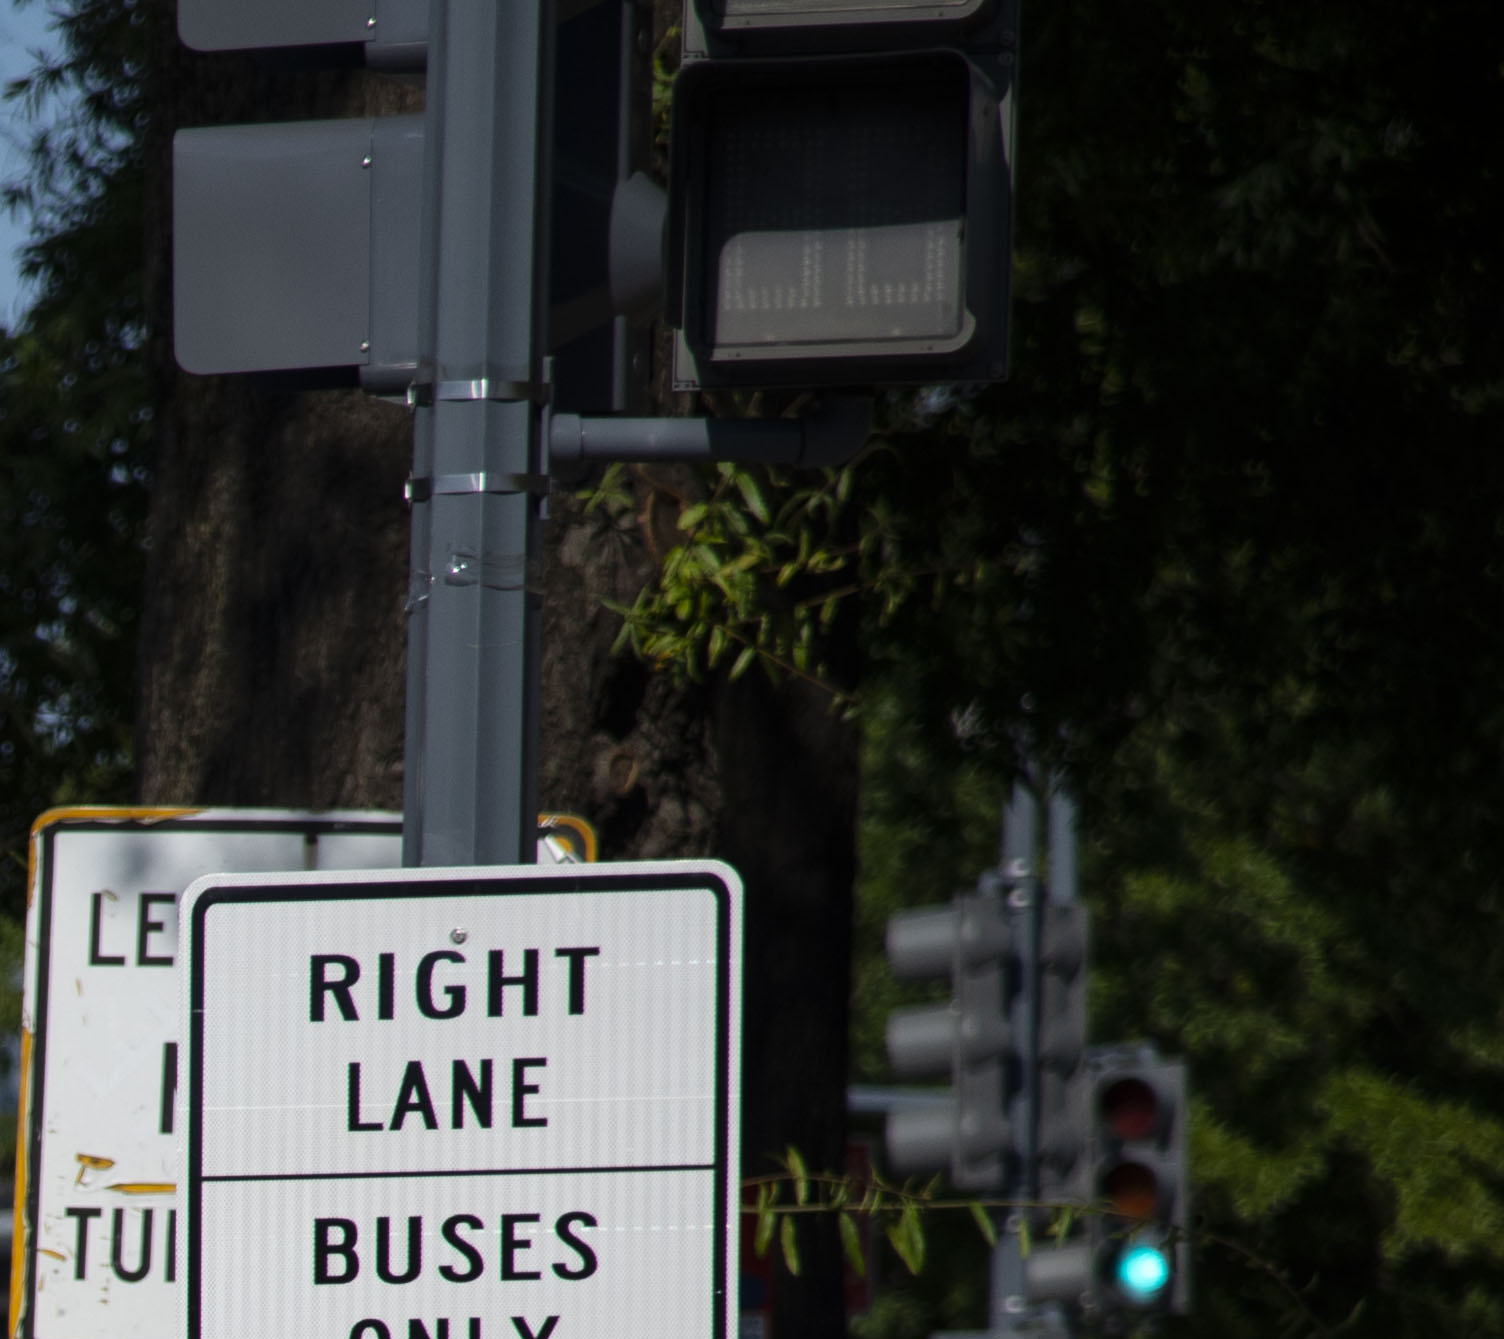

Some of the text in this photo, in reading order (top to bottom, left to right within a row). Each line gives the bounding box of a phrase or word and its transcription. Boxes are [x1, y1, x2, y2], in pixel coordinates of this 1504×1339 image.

[88, 891, 177, 967] LE
[308, 945, 602, 1023] RIGHT
[346, 1056, 550, 1132] LANE
[65, 1206, 177, 1283] TU
[313, 1210, 600, 1286] BUSES
